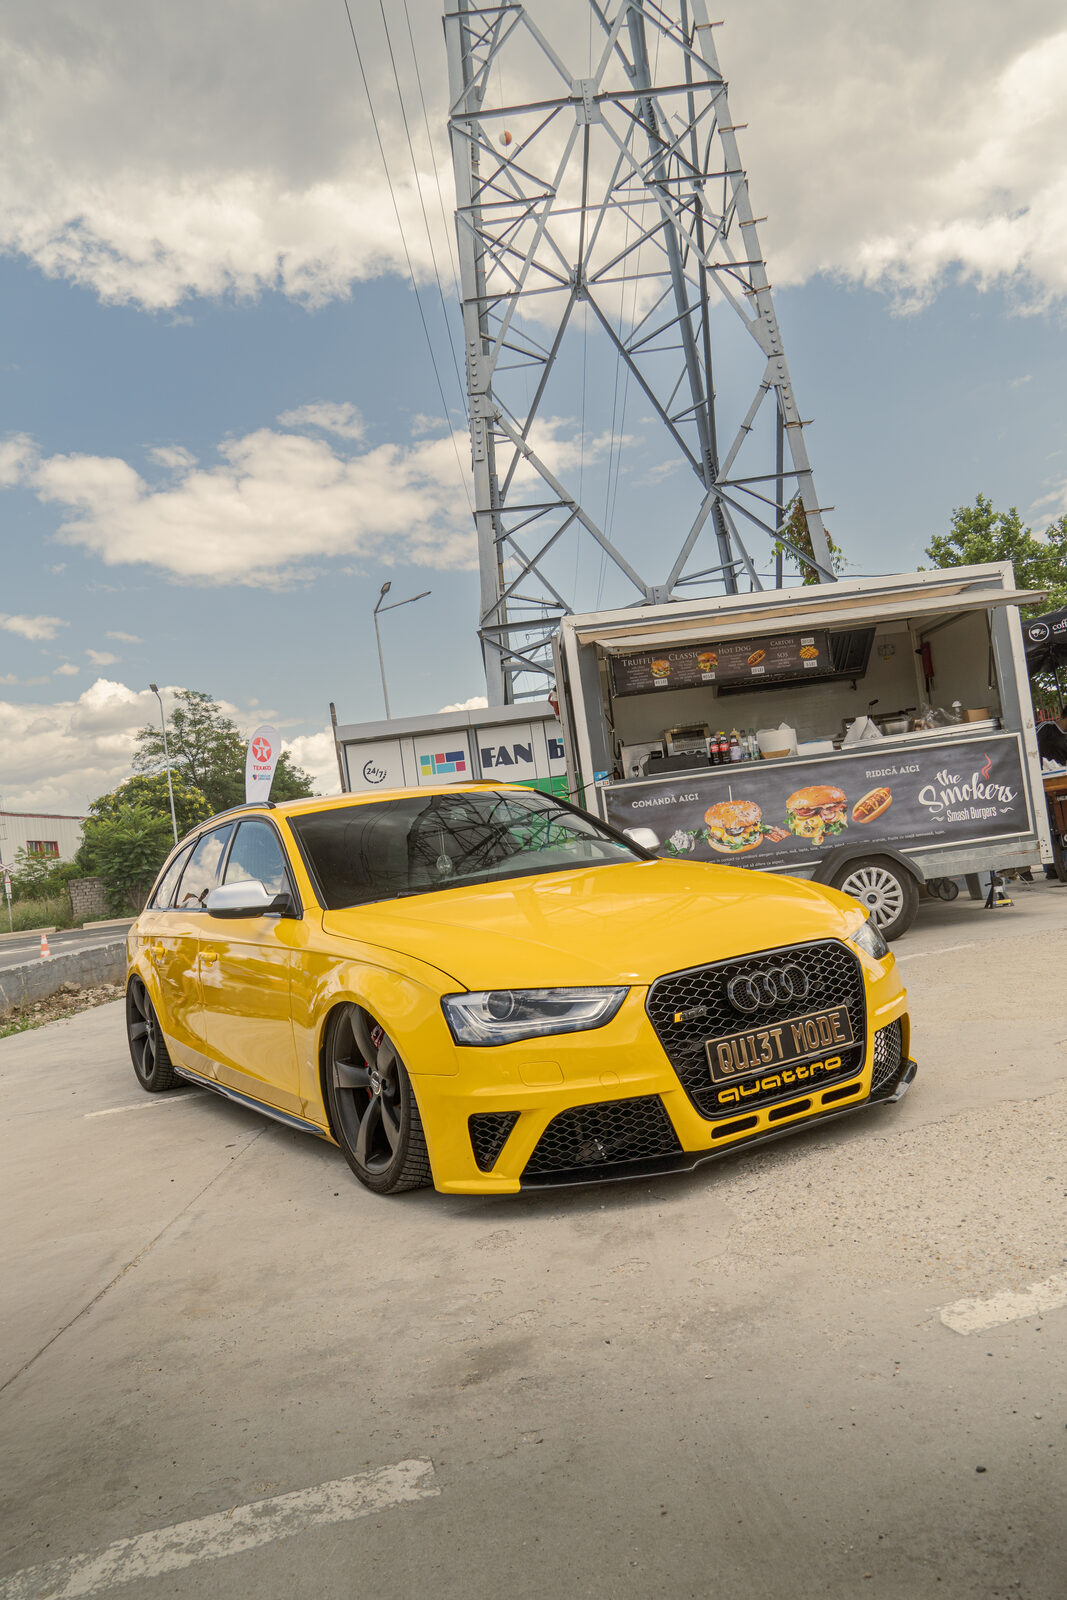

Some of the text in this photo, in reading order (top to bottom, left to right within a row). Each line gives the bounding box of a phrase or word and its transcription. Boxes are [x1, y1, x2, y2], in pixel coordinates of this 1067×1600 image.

[668, 651, 700, 661] CLASSIC
[718, 645, 752, 655] HOT DOG
[622, 657, 656, 667] TRUFFLE
[481, 742, 534, 768] FAN
[366, 767, 384, 778] 24/7
[866, 765, 920, 778] RIDICĂ AICI
[934, 769, 963, 785] the
[631, 792, 699, 808] COMANDĂ AICI
[918, 772, 1018, 813] Smokers
[946, 806, 997, 822] Smash Burgers
[716, 1012, 845, 1074] QUI3T MODE
[717, 1056, 842, 1103] quattro
